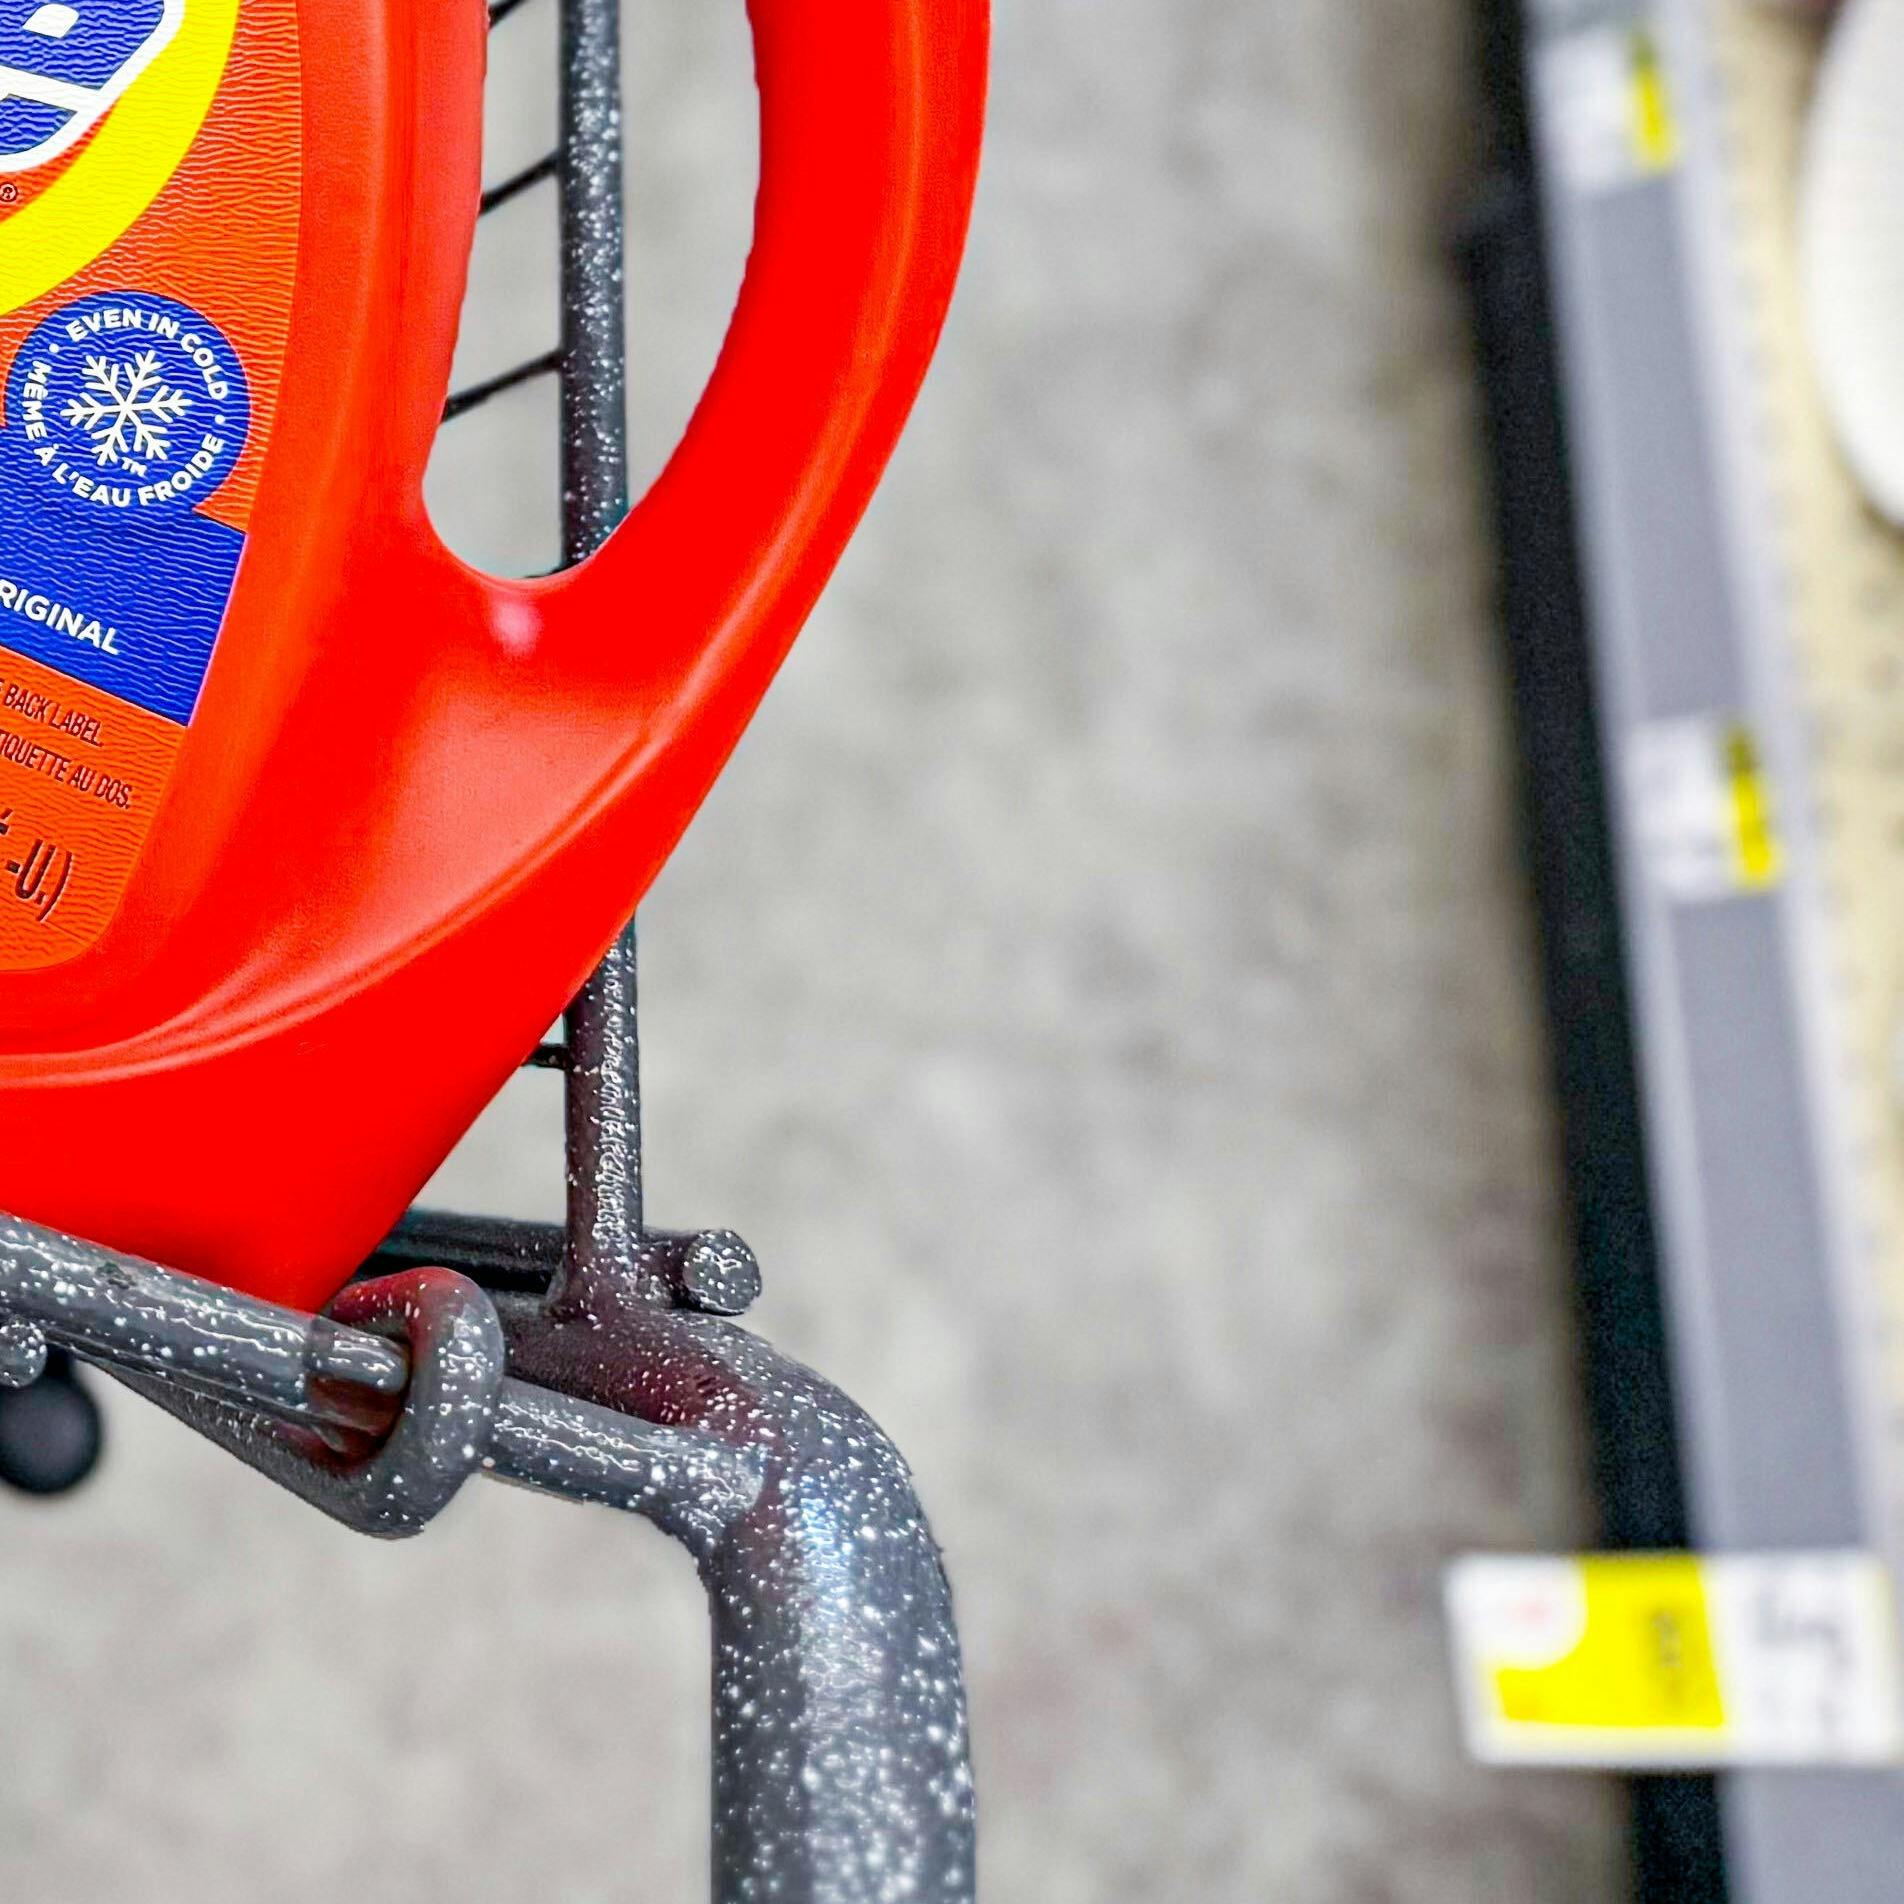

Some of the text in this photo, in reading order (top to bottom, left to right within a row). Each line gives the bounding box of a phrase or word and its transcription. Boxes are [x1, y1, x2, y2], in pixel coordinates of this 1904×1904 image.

[65, 309, 229, 400] EVEN IN COLD
[22, 360, 225, 508] MÊME À L'EAU FROIDE
[3, 683, 51, 722] BACK
[49, 701, 105, 748] LABEL.
[68, 763, 95, 793] AU
[94, 774, 132, 810] DOS.
